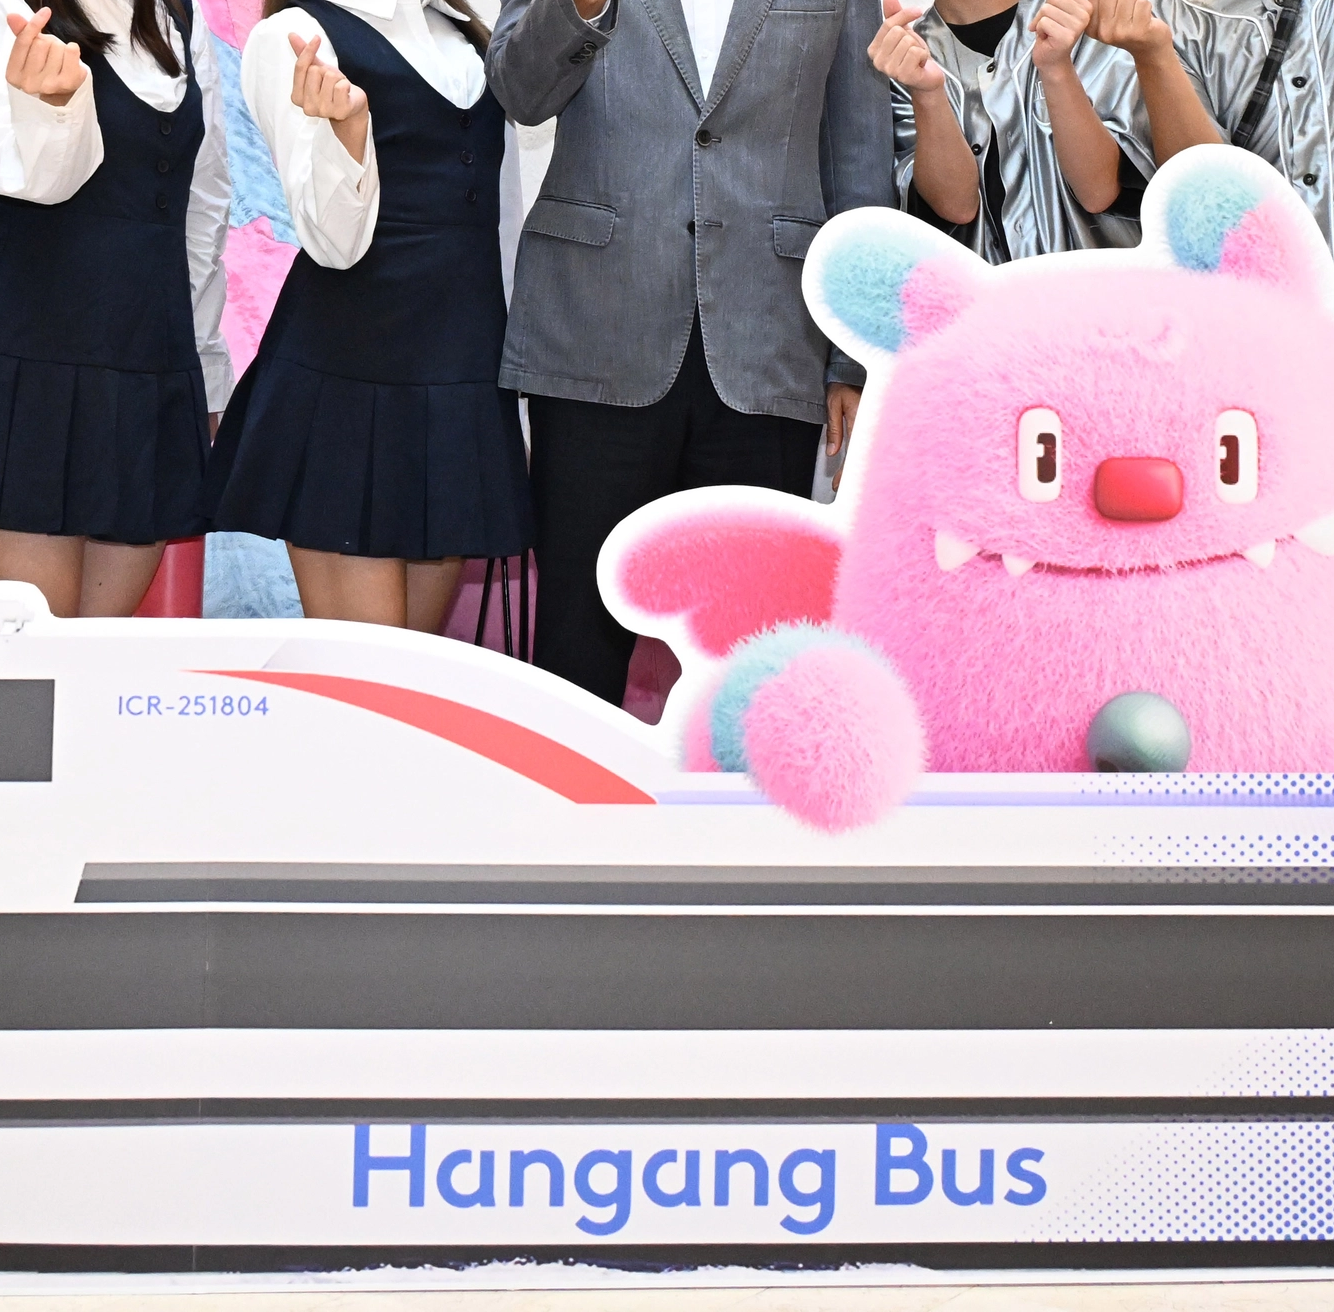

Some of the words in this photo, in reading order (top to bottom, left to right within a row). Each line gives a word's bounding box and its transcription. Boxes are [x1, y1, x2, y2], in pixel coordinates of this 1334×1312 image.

[117, 695, 270, 718] ICR-251804
[352, 1124, 836, 1236] Hangang
[874, 1124, 1048, 1207] Bus
